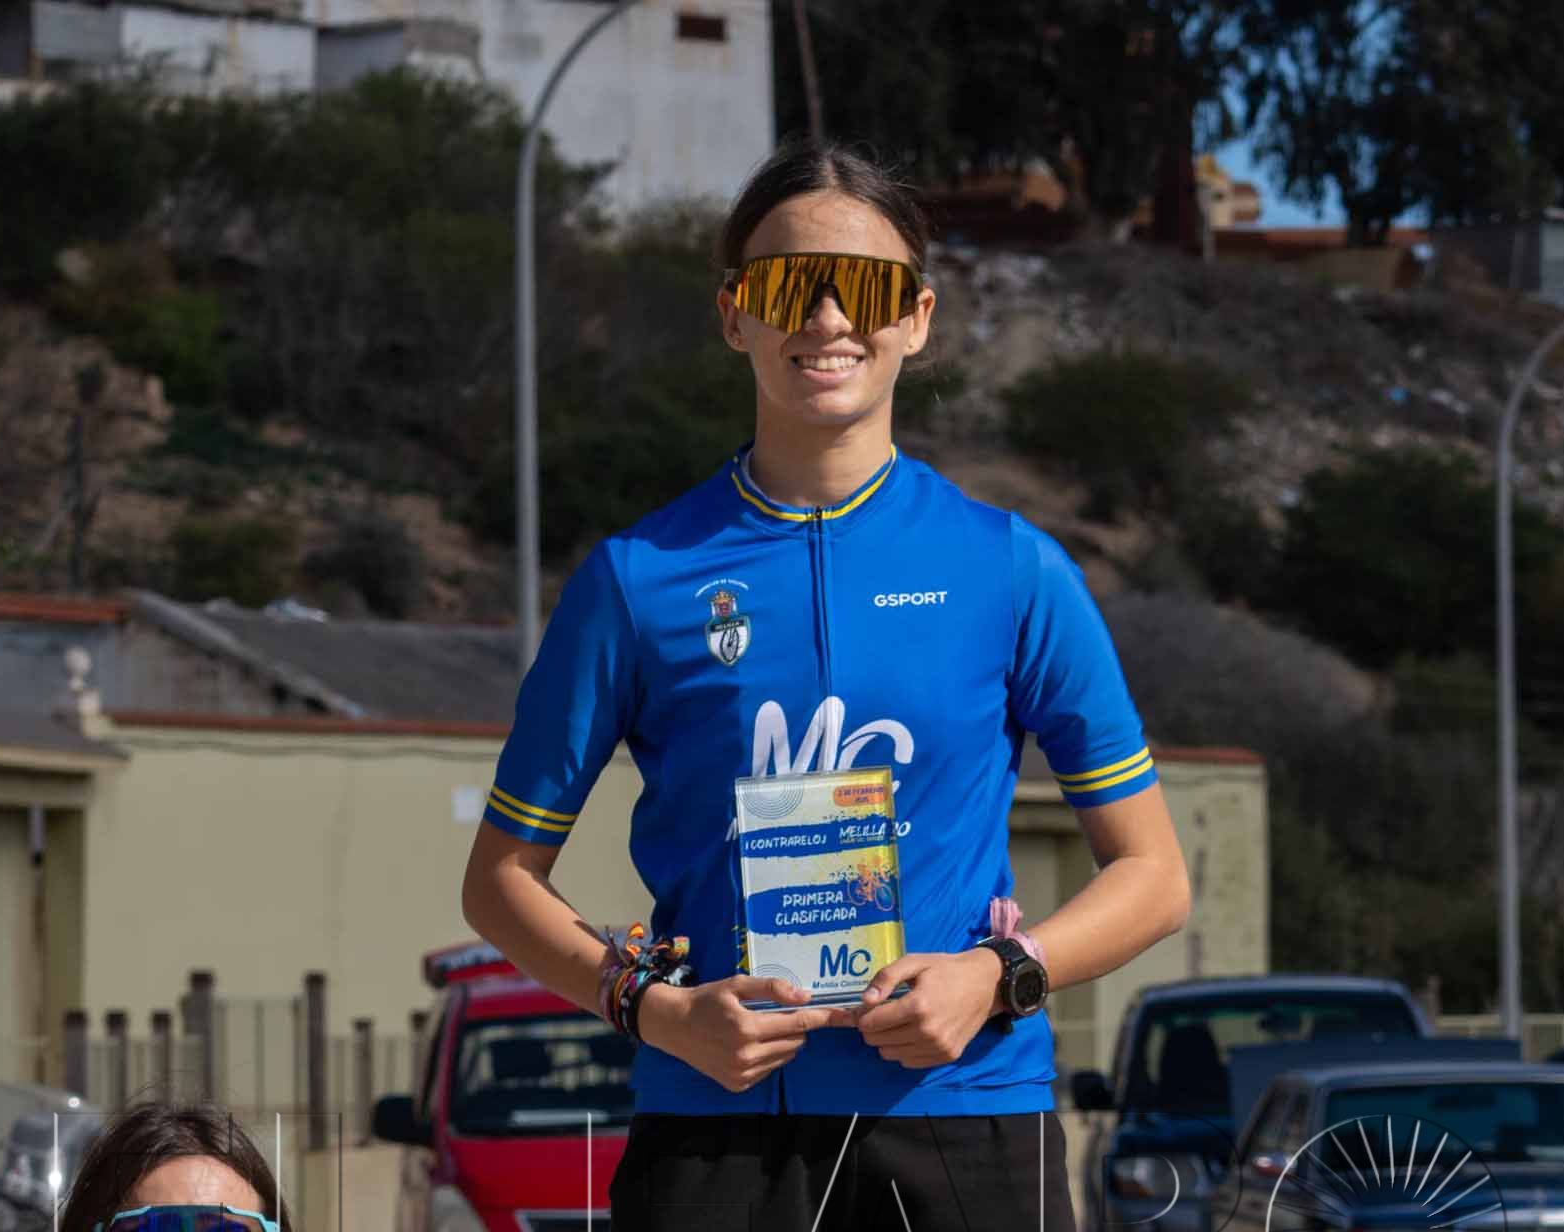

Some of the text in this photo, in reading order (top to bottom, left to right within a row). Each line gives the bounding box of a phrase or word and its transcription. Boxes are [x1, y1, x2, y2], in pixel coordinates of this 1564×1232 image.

[874, 590, 948, 608] GSPORT
[839, 822, 886, 840] MELILLA
[751, 835, 827, 850] CONTRARELOJ
[783, 891, 844, 908] PRIMERA
[776, 909, 857, 925] CLASIFICADA
